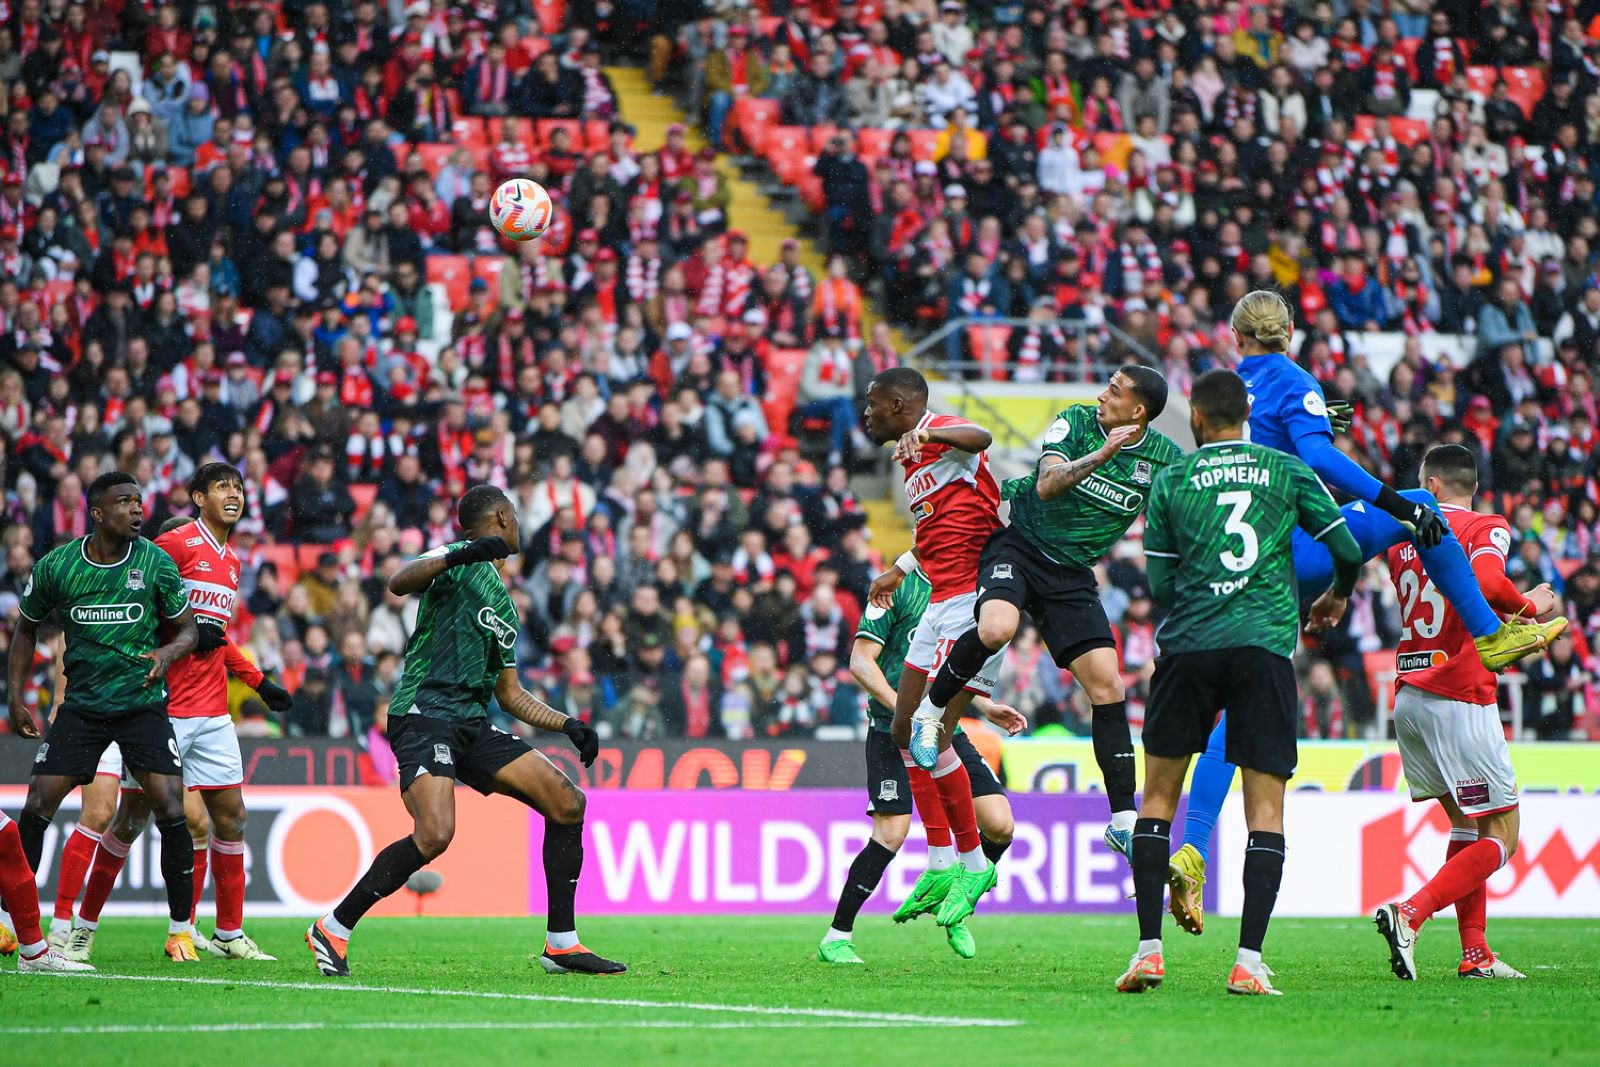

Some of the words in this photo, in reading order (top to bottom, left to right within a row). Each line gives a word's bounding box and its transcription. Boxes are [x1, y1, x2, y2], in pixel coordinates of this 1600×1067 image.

[1190, 466, 1270, 490] ТОРМЕНА
[1216, 490, 1259, 572] 3
[77, 609, 124, 620] Winline
[168, 737, 182, 768] 9
